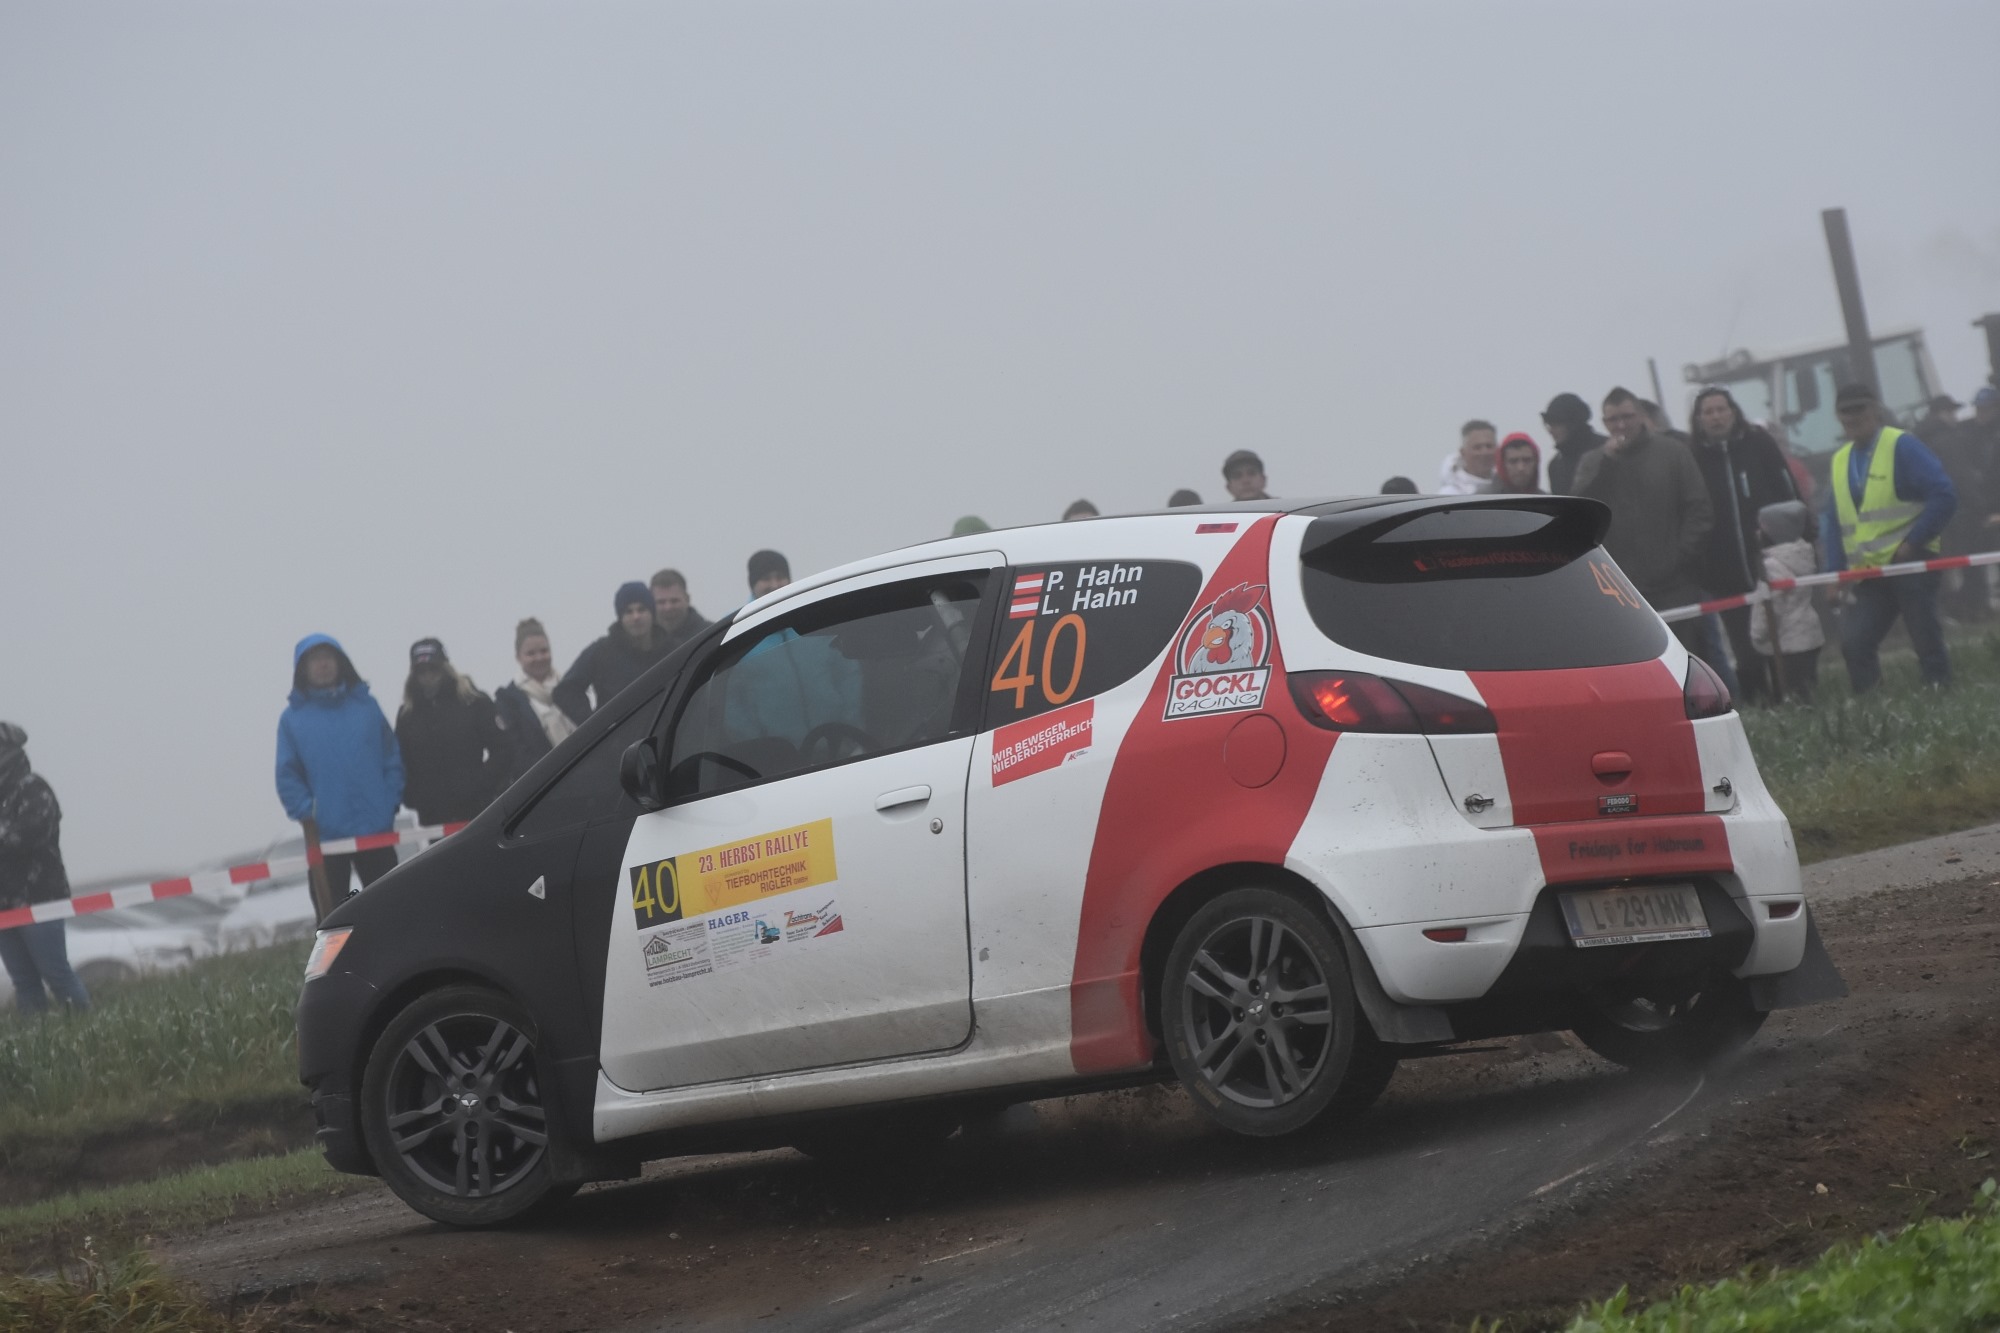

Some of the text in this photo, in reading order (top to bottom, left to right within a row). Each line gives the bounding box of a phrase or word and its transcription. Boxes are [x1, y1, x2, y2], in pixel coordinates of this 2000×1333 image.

[1046, 563, 1143, 592] P. Hahn
[1588, 560, 1641, 610] 40
[1041, 587, 1138, 615] L. Hahn
[991, 613, 1087, 709] 40
[1175, 672, 1261, 700] GOCKL
[1172, 693, 1258, 713] RACING
[992, 720, 1067, 764] WIR BEWEGEN
[1607, 797, 1630, 806] FERODO
[698, 830, 809, 874] 23. HERBST RALLYE
[1569, 836, 1705, 860] Fridays for Hubraum
[725, 860, 807, 890] TIEFBOHRTECHNIK
[760, 877, 793, 894] RIGLER
[633, 860, 680, 919] 40
[708, 911, 751, 930] HAGER
[1589, 900, 1606, 931] L
[646, 940, 669, 957] HOLZBAU
[1583, 936, 1634, 947] HIMMELBAUER
[647, 948, 692, 966] LAMPRECHT
[649, 967, 713, 988] www.holzbau-lamprecht.at
